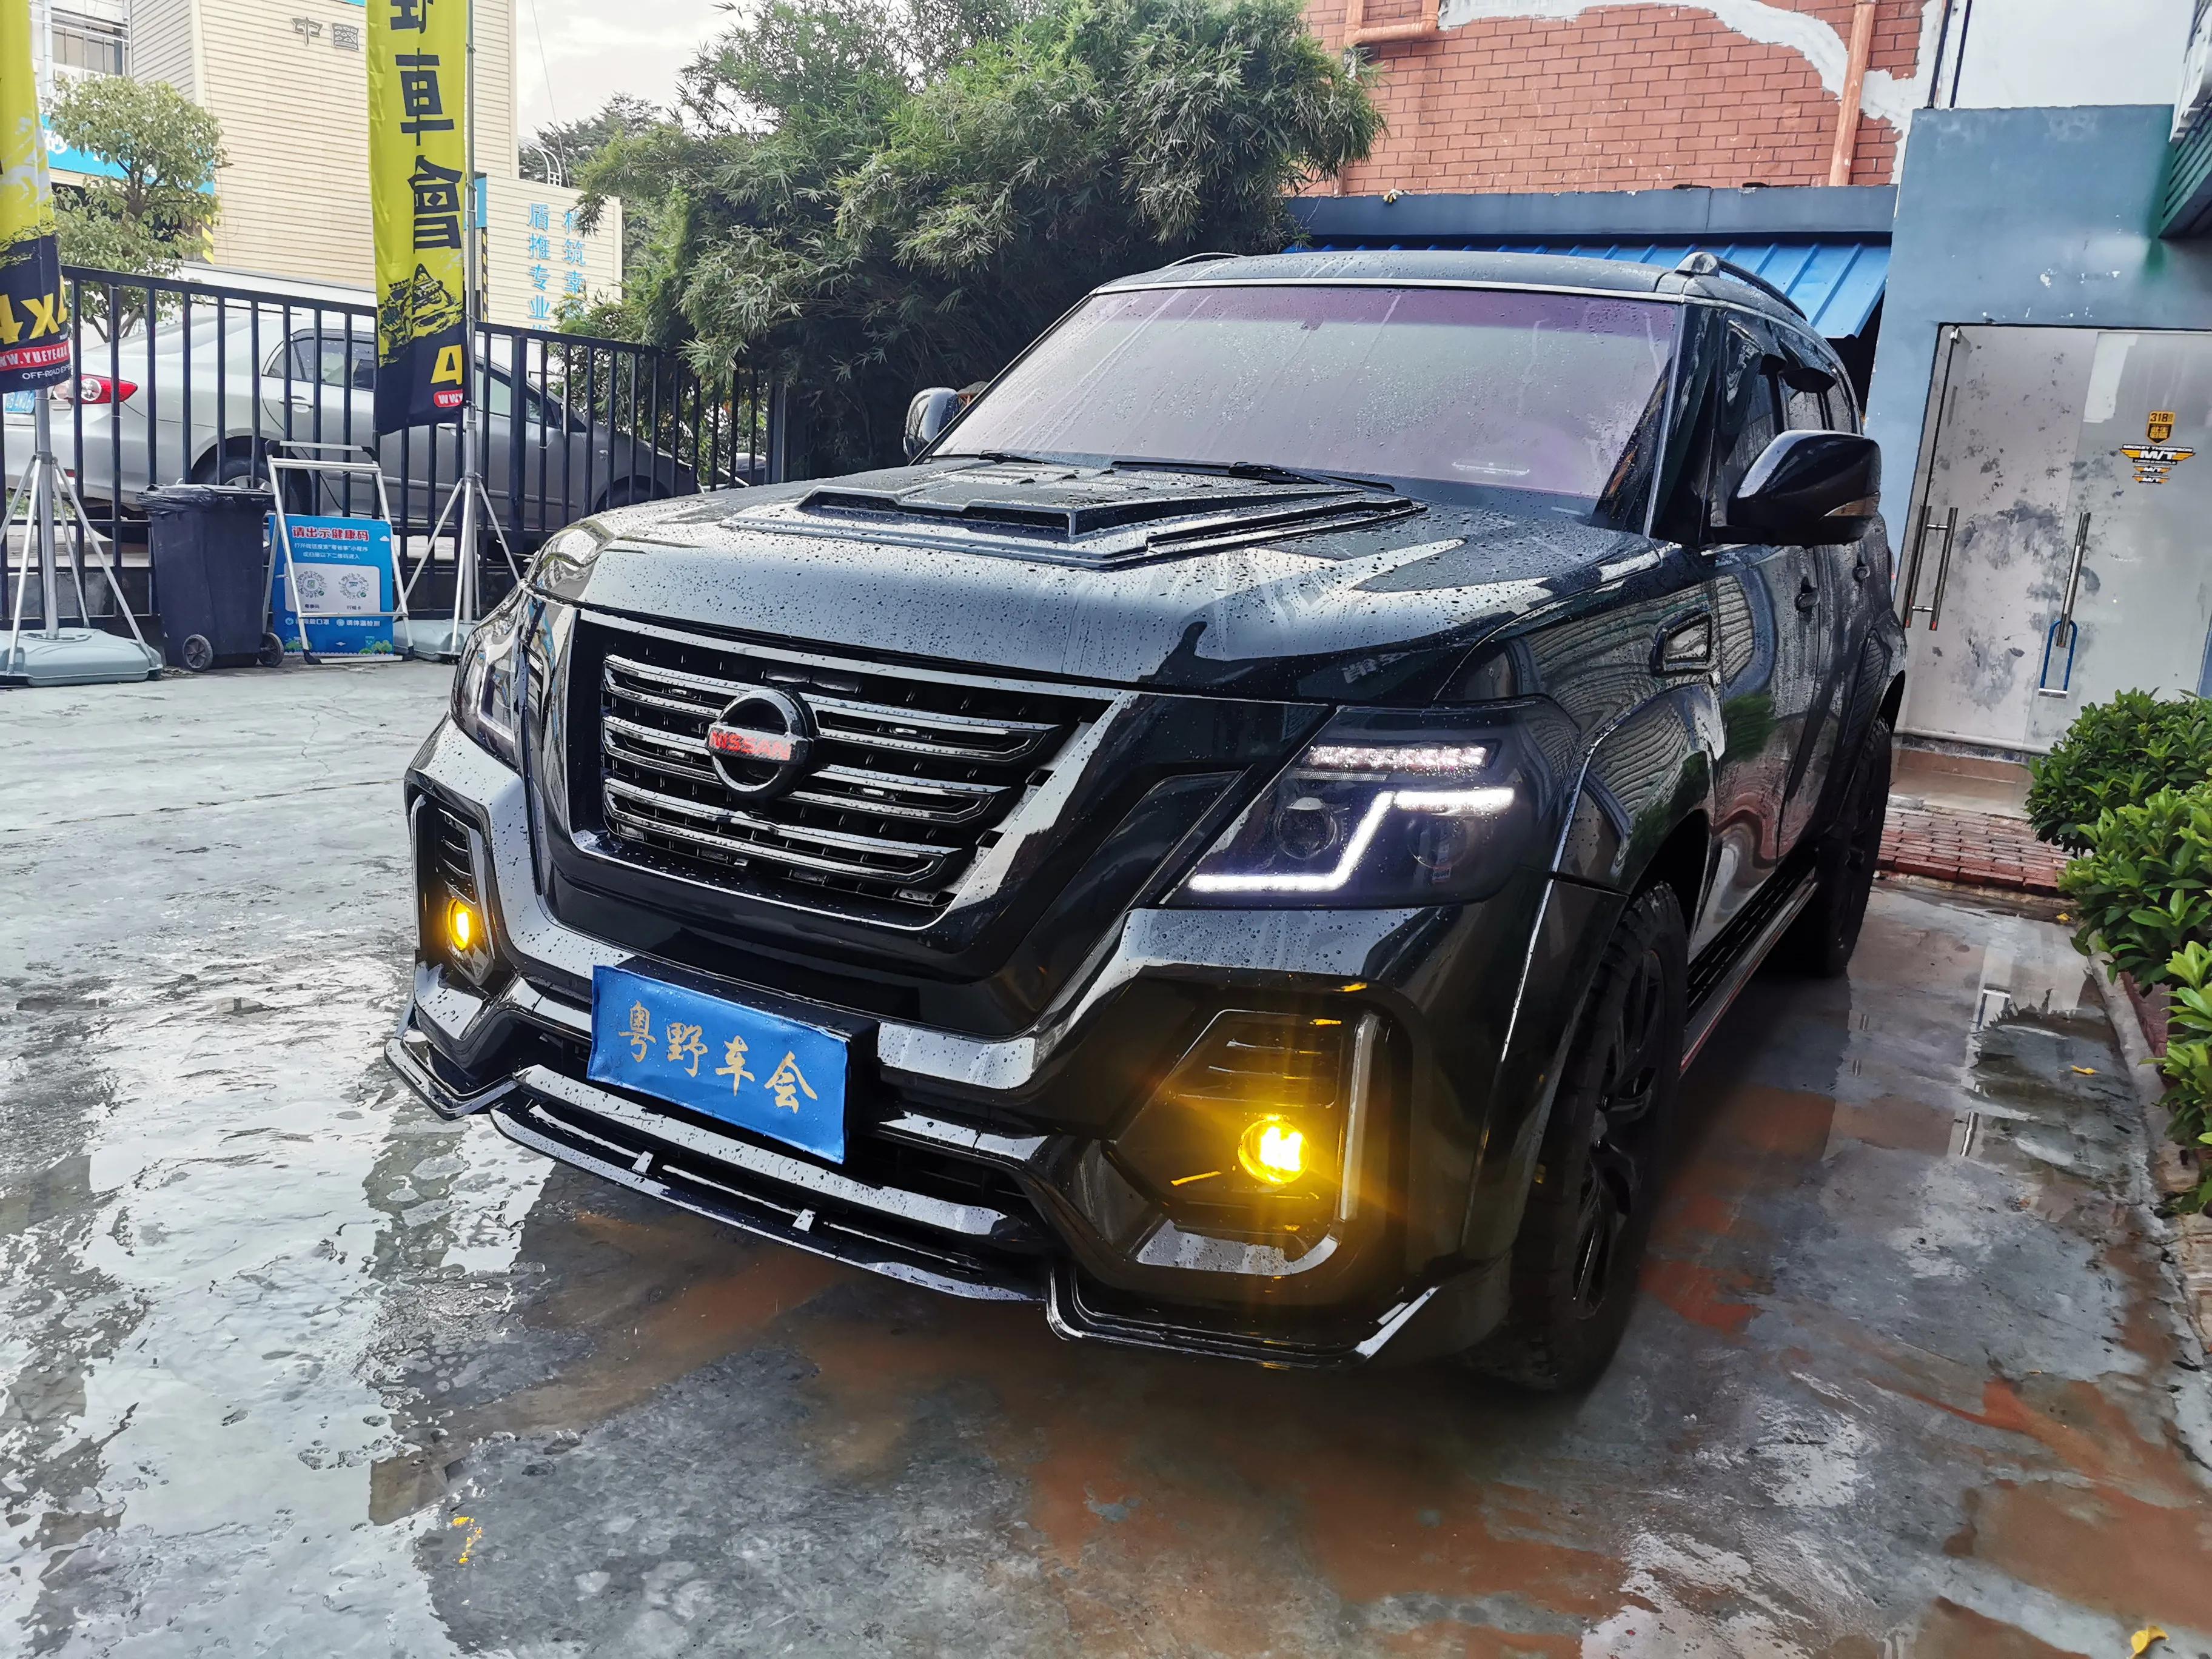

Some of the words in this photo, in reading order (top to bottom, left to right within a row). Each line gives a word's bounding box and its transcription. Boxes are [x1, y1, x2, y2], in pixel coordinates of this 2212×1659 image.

[527, 202, 551, 331] 盾推专业
[2140, 451, 2177, 460] M/T
[709, 731, 791, 760] NISSAN
[618, 1000, 818, 1114] 粤野车会
